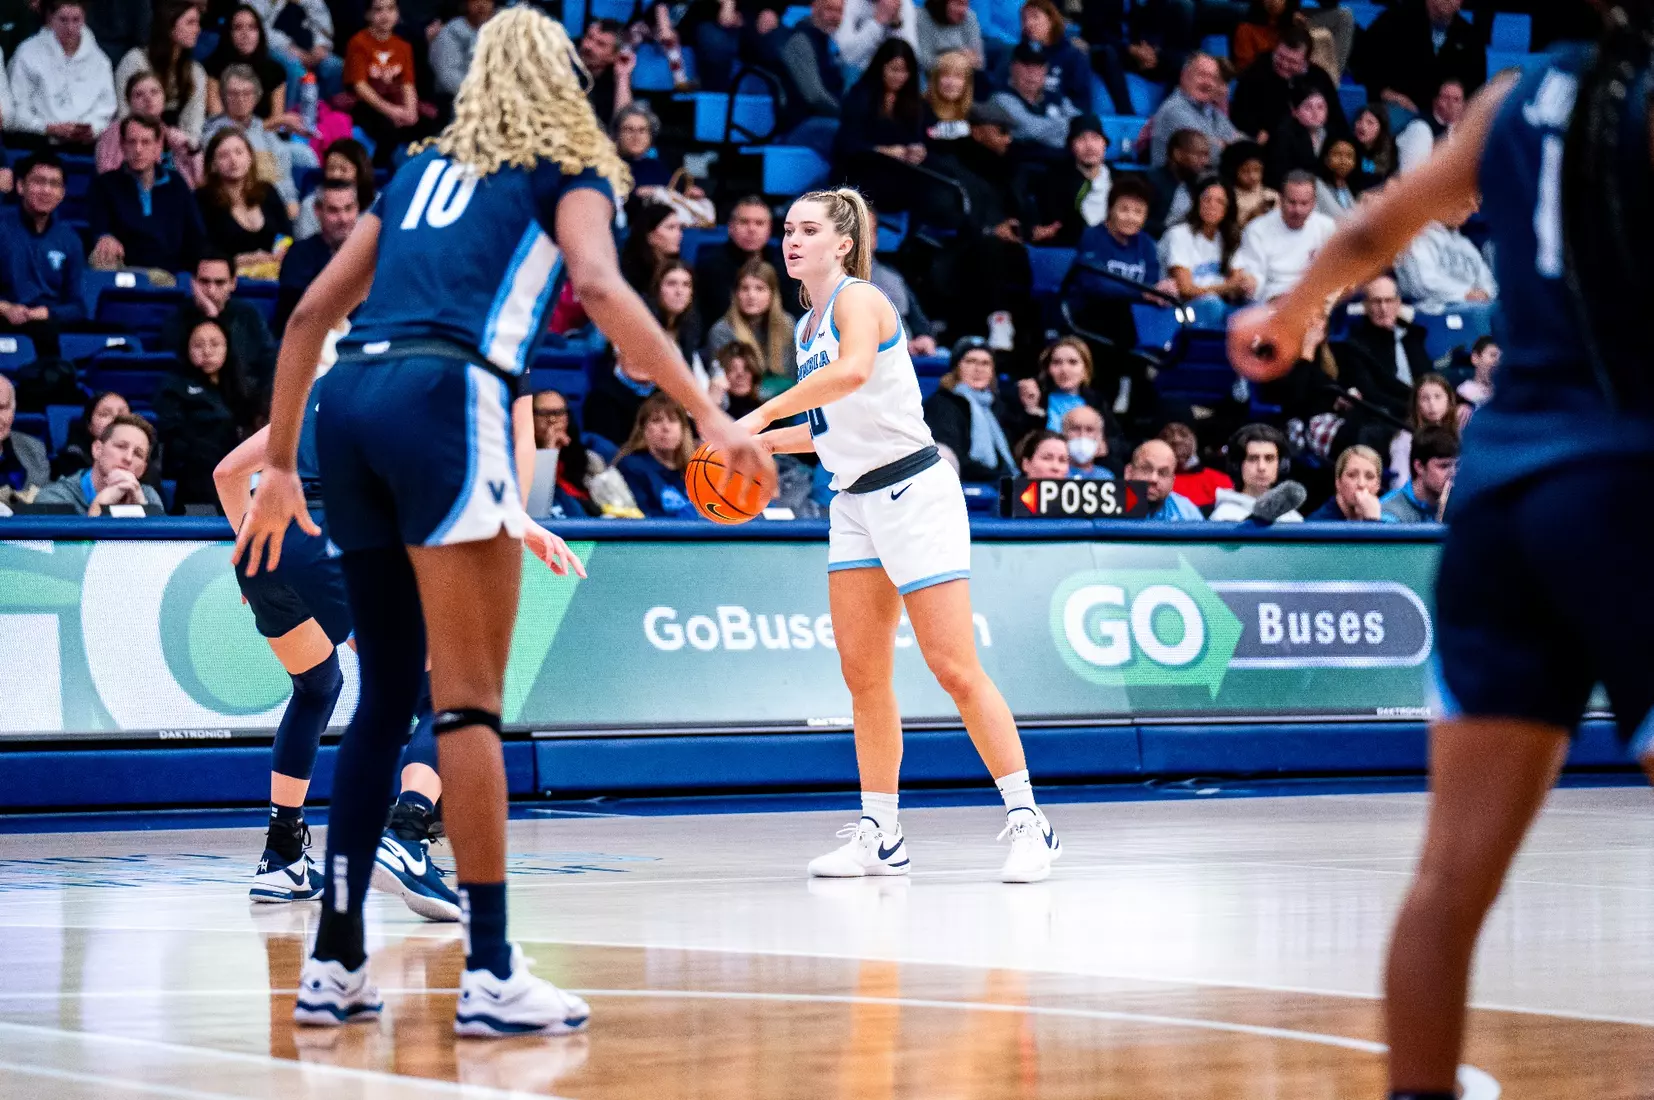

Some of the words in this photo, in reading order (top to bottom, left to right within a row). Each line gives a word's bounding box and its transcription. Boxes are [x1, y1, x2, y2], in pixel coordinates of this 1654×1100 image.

[400, 158, 479, 230] 10
[487, 479, 506, 504] V
[1040, 481, 1122, 514] POSS.
[1063, 584, 1205, 667] GO
[1257, 602, 1386, 646] Buses
[159, 729, 232, 740] DAKTRONICS
